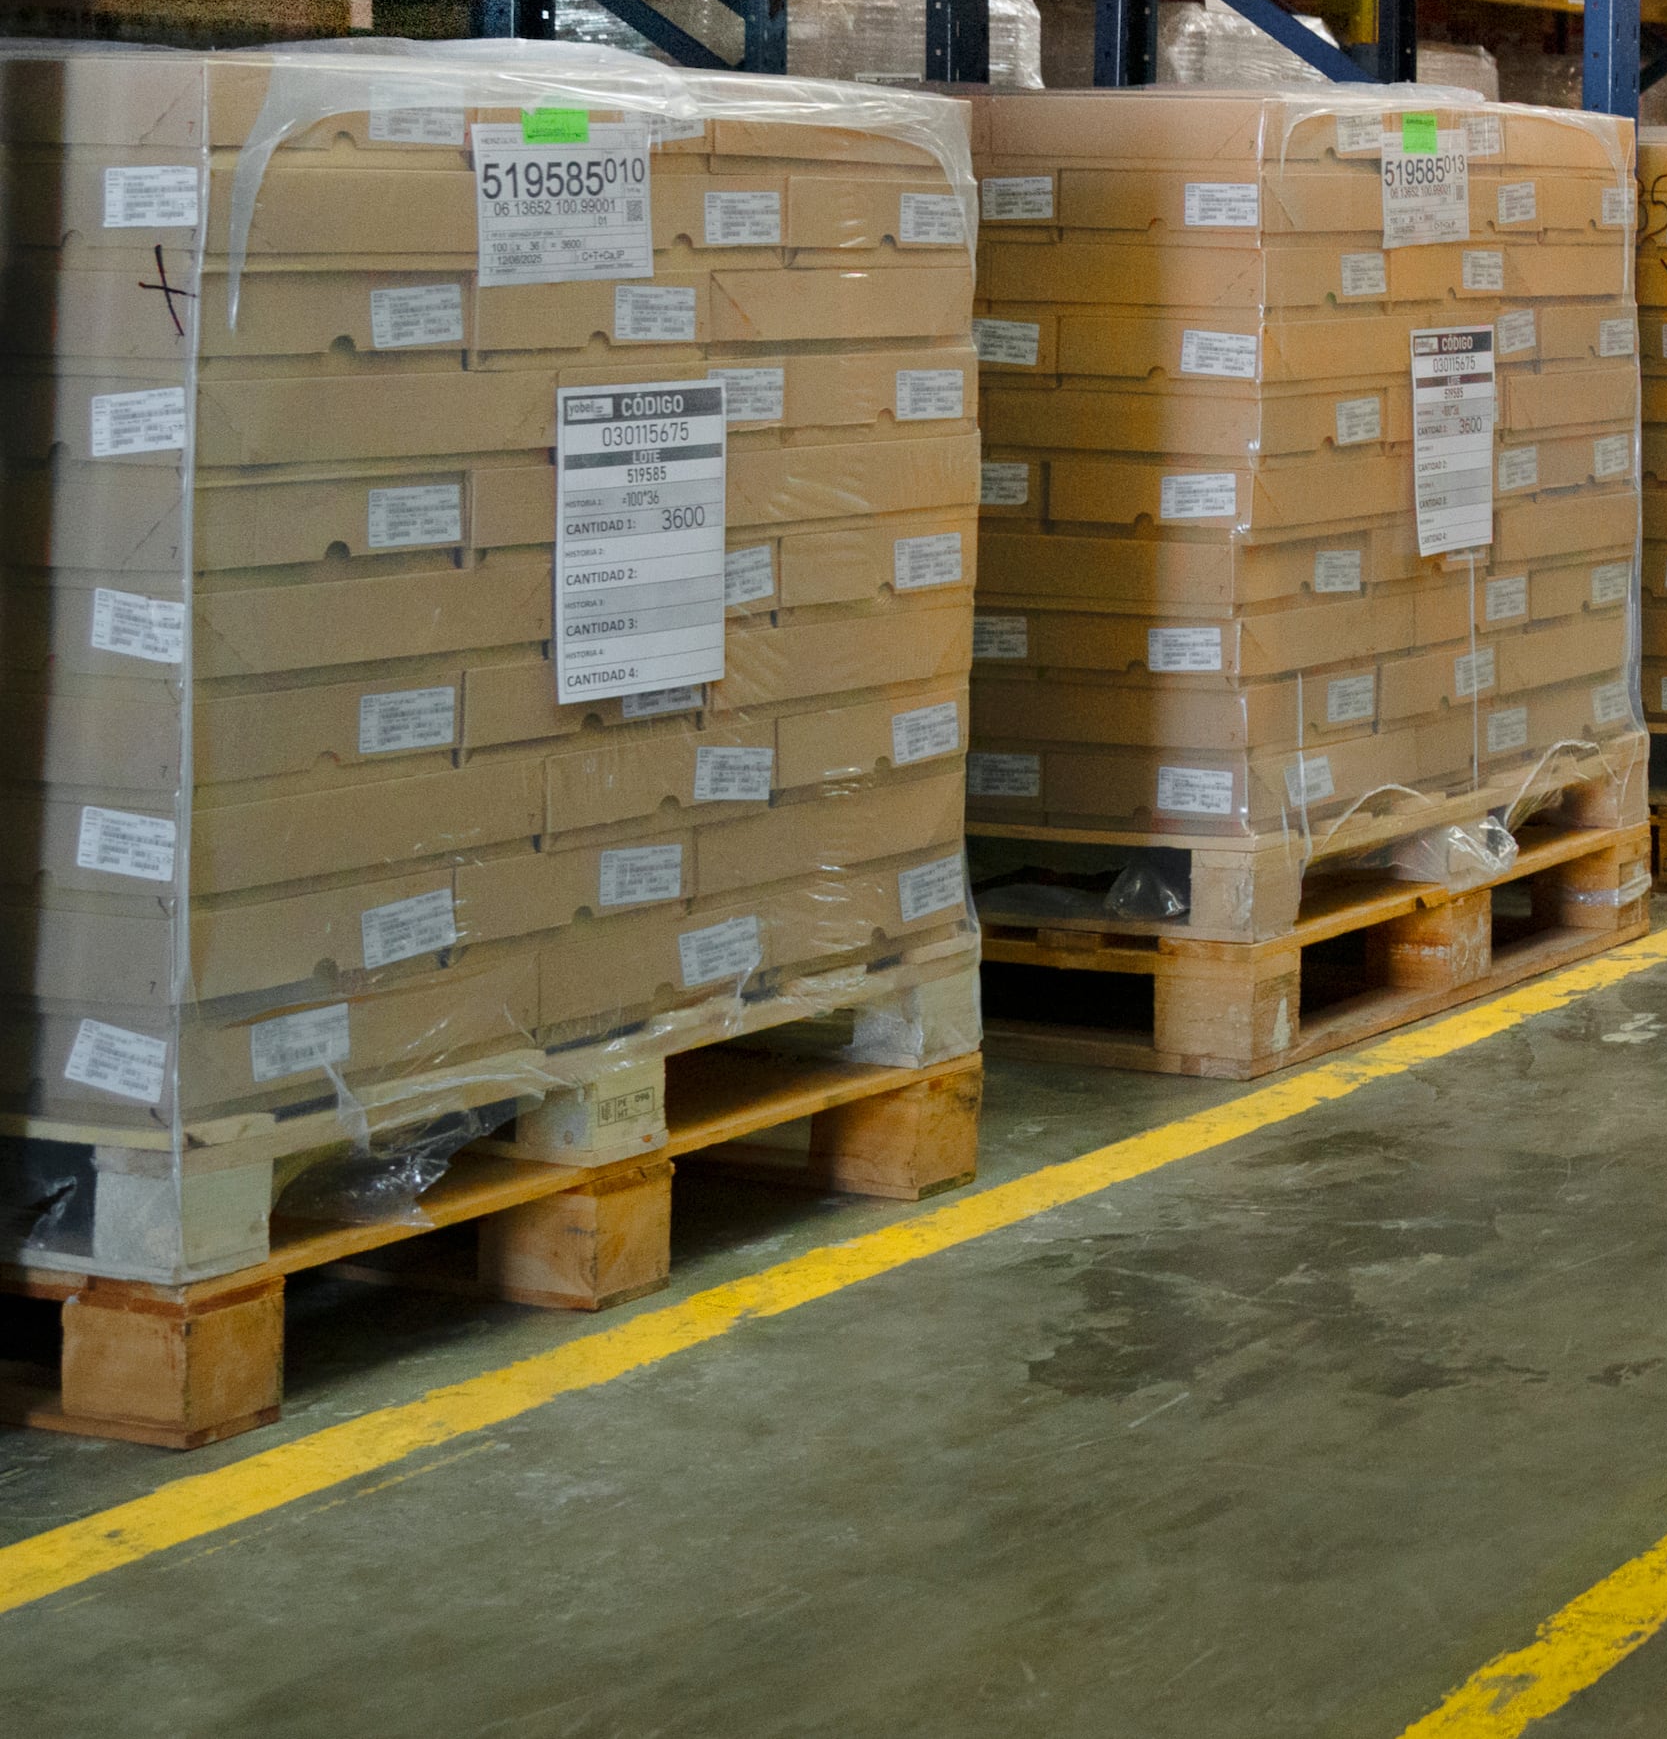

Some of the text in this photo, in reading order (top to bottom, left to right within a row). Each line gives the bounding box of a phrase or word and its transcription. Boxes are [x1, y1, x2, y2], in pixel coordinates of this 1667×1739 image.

[515, 200, 551, 215] 13652
[1441, 334, 1473, 351] CÓDIGO
[568, 400, 594, 416] yobel
[621, 393, 684, 416] CÓDIGO
[602, 421, 690, 447] 030115675
[632, 450, 661, 463] LOTE
[626, 466, 667, 484] 519585
[661, 505, 706, 530] 3600
[566, 520, 624, 535] CANTIDAD
[566, 569, 625, 586] CANTIDAD
[566, 619, 625, 637] CANTIDAD
[567, 669, 626, 687] CANTIDAD
